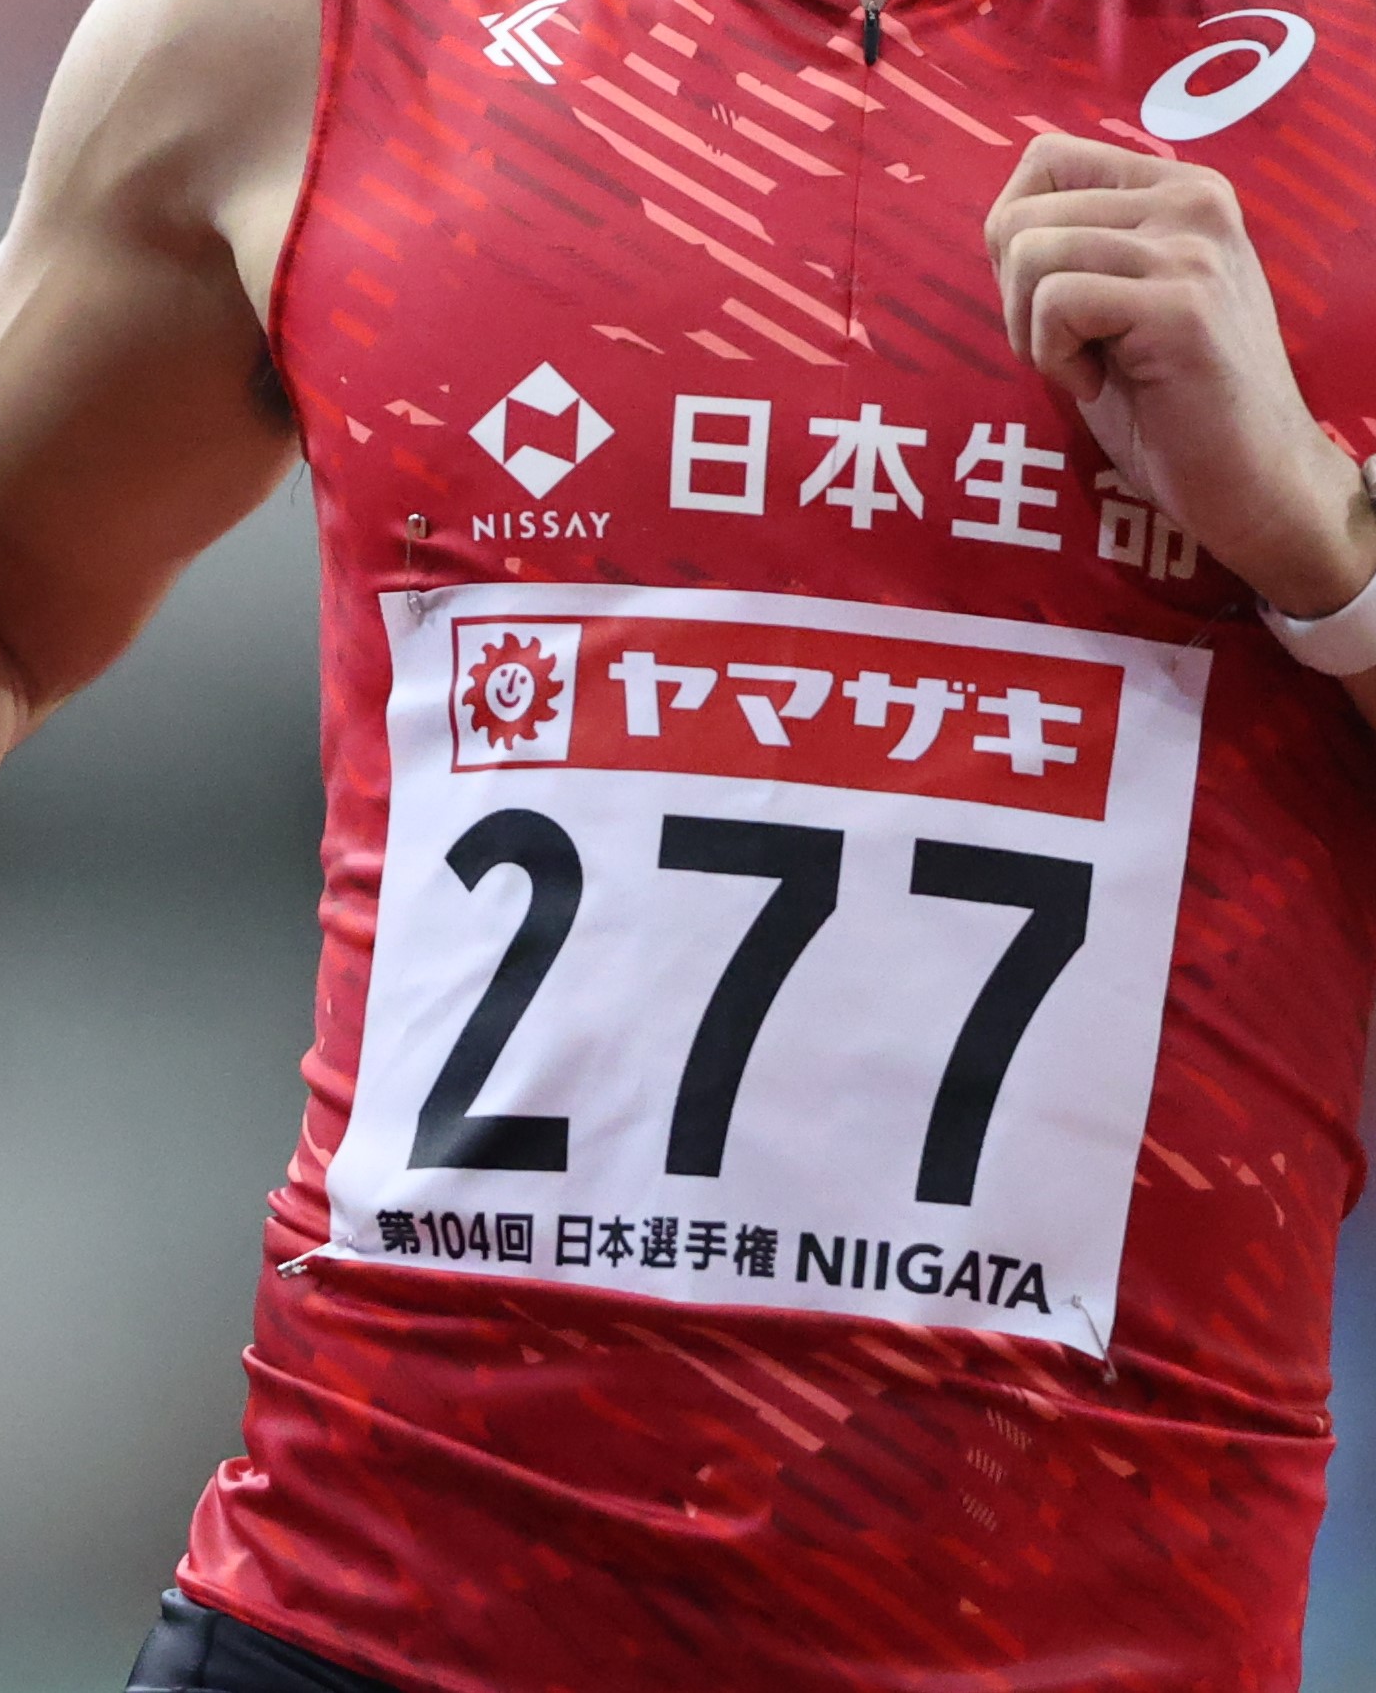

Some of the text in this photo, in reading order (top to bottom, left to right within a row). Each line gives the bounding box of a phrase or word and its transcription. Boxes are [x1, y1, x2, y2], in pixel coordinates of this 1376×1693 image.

[471, 510, 613, 542] NISSAY
[608, 650, 1082, 777] ヤマザキ
[406, 808, 1094, 1207] 277
[376, 1209, 1053, 1314] 第104回 日本選手権 NIIGATA
